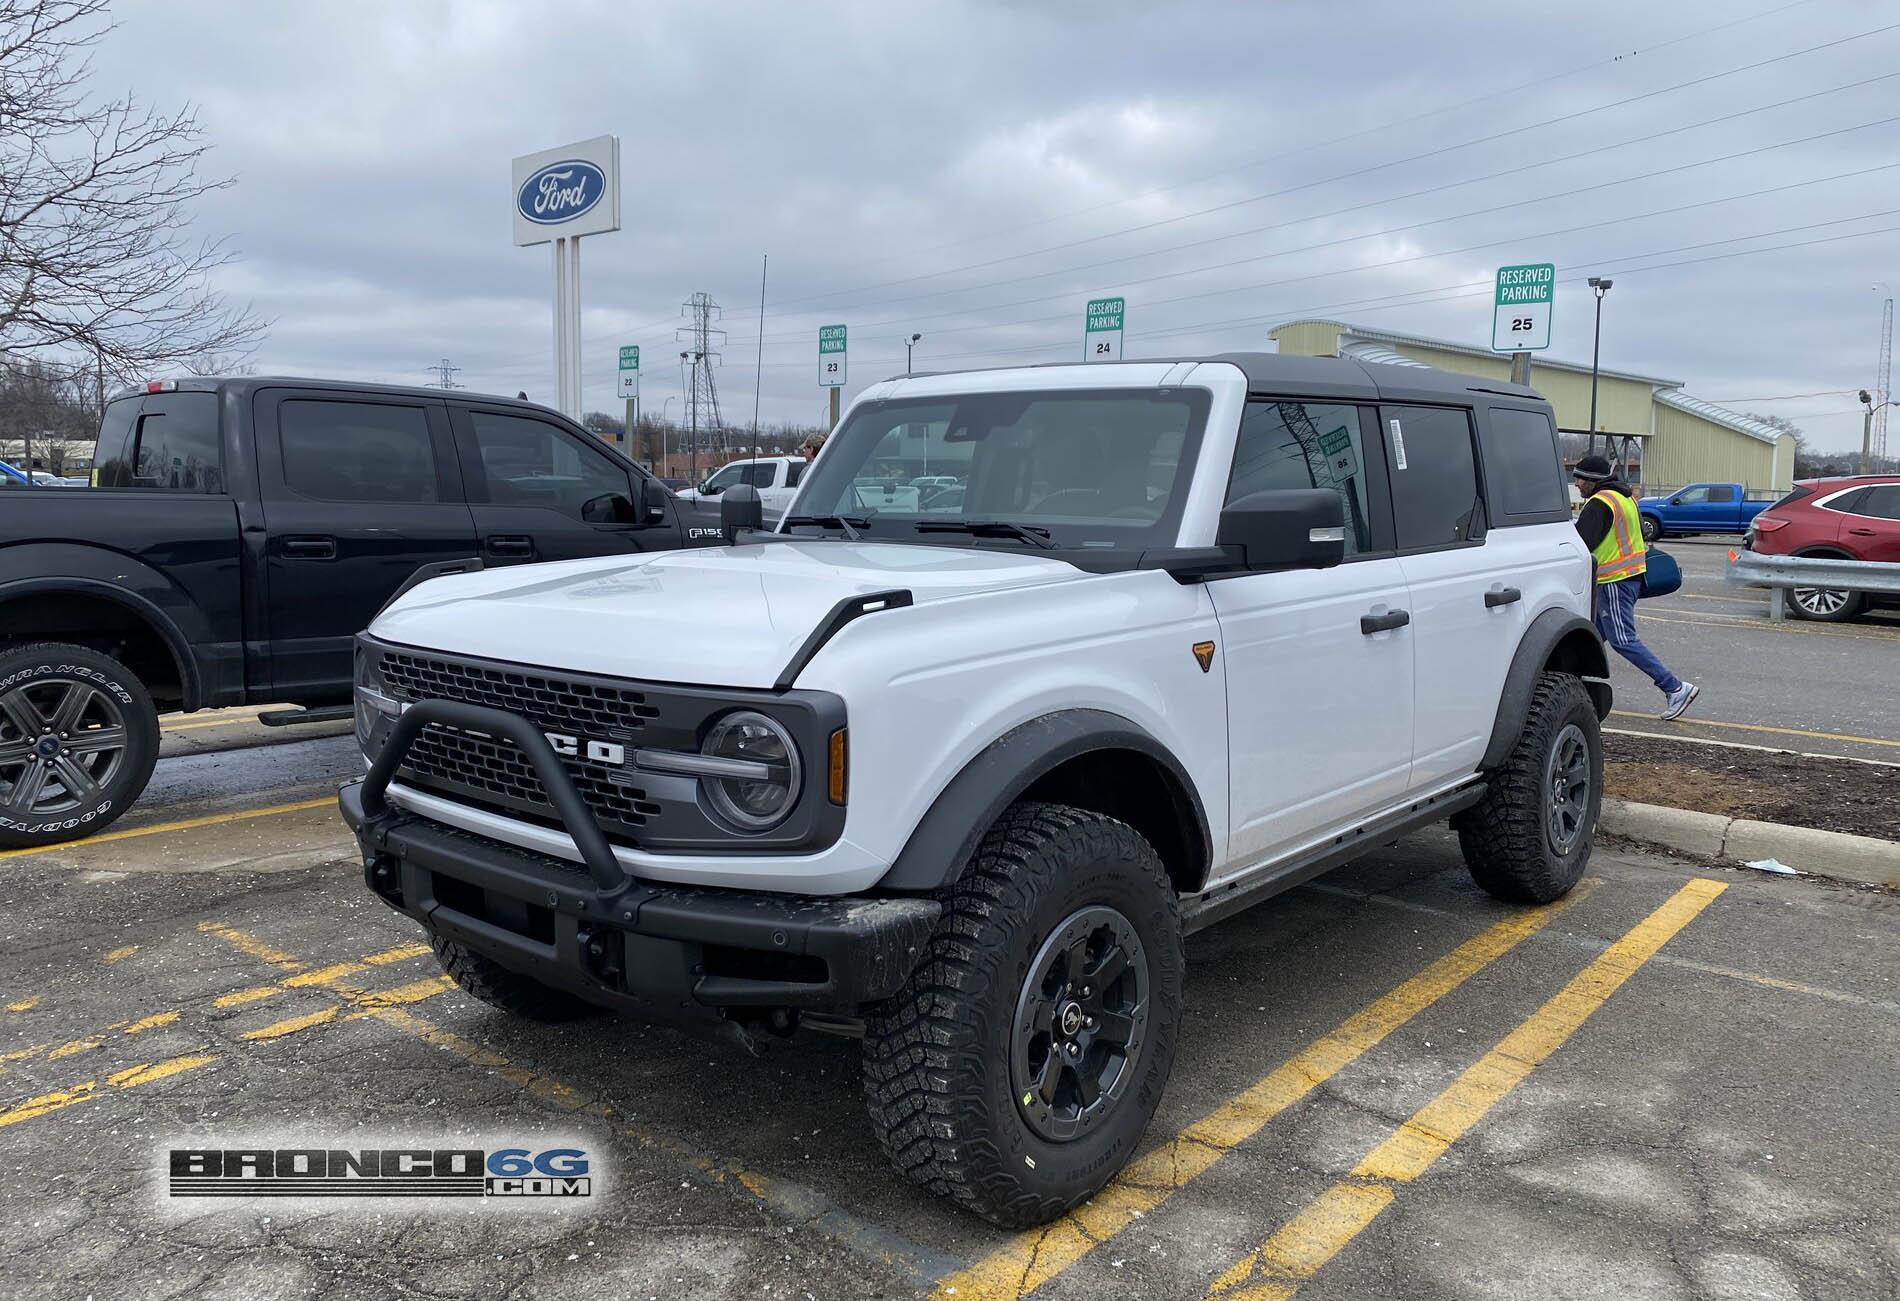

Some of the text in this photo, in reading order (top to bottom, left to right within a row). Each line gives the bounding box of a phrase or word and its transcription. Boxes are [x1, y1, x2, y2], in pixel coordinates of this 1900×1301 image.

[534, 170, 586, 214] Ford
[1499, 268, 1551, 285] RESERVED
[1501, 285, 1547, 301] PARKING
[1088, 301, 1123, 316] RESERVED
[1089, 315, 1120, 329] PARKING
[1511, 318, 1533, 332] 25
[1096, 342, 1110, 354] 24
[827, 362, 838, 372] 23
[624, 378, 632, 386] 22
[0, 664, 133, 704] WRANGLER
